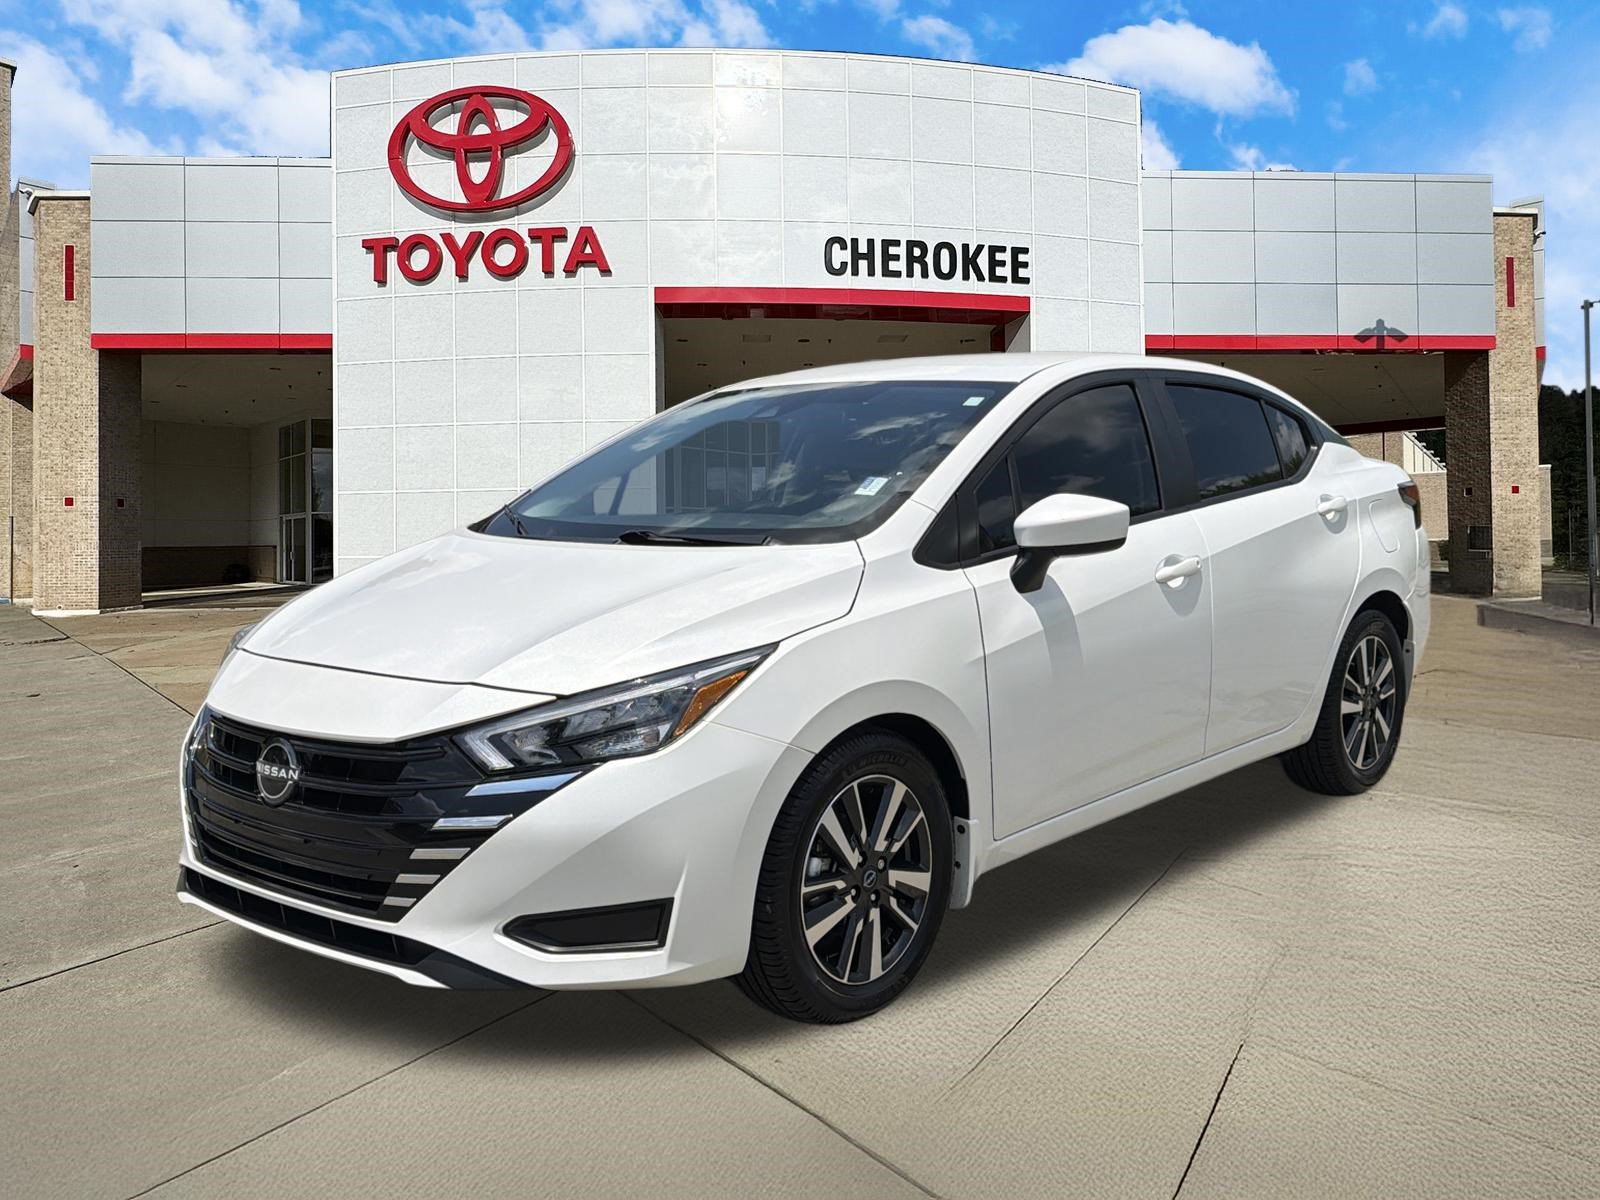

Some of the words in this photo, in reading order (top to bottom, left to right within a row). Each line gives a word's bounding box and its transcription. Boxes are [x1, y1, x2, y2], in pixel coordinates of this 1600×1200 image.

[362, 226, 612, 285] TOYOTA
[824, 236, 1030, 285] CHEROKEE
[256, 761, 299, 780] NISSAN
